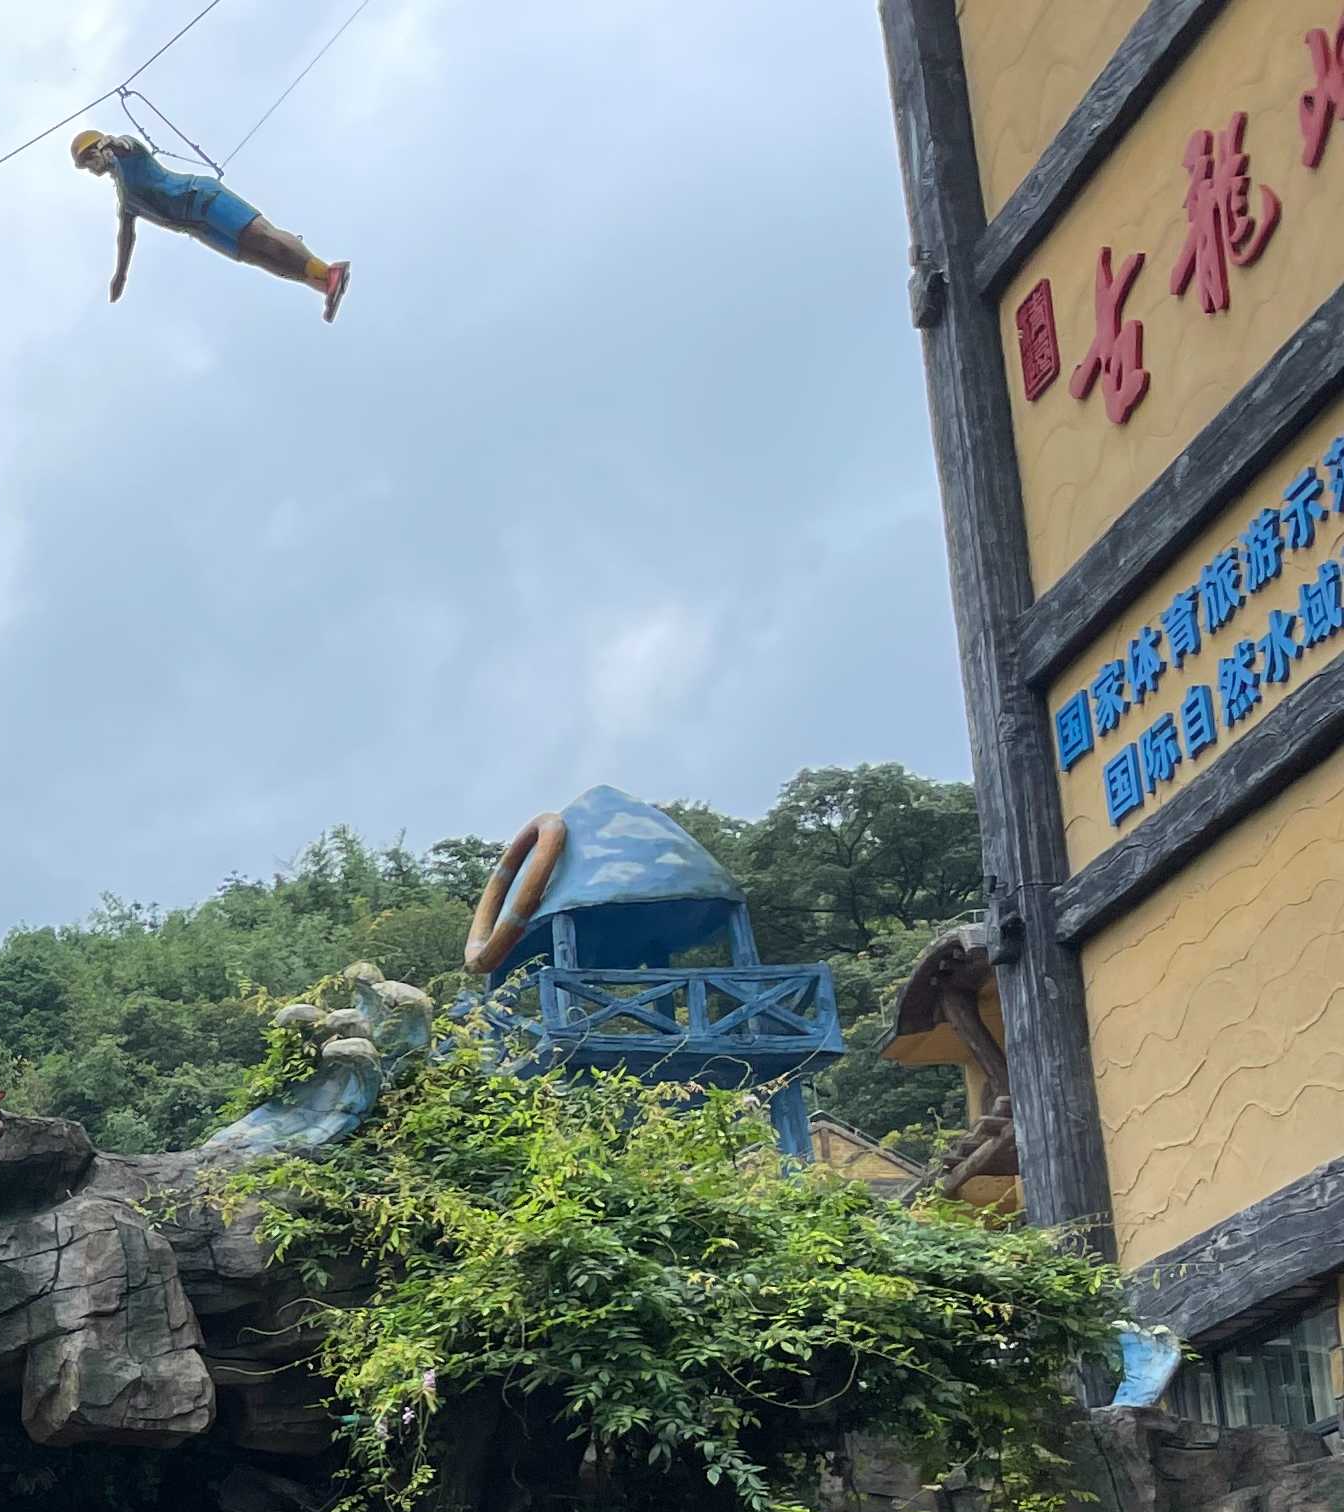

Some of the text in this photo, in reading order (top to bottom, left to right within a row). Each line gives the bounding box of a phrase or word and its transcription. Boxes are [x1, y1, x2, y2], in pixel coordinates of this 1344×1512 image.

[1102, 560, 1344, 827] 国际自然水域
